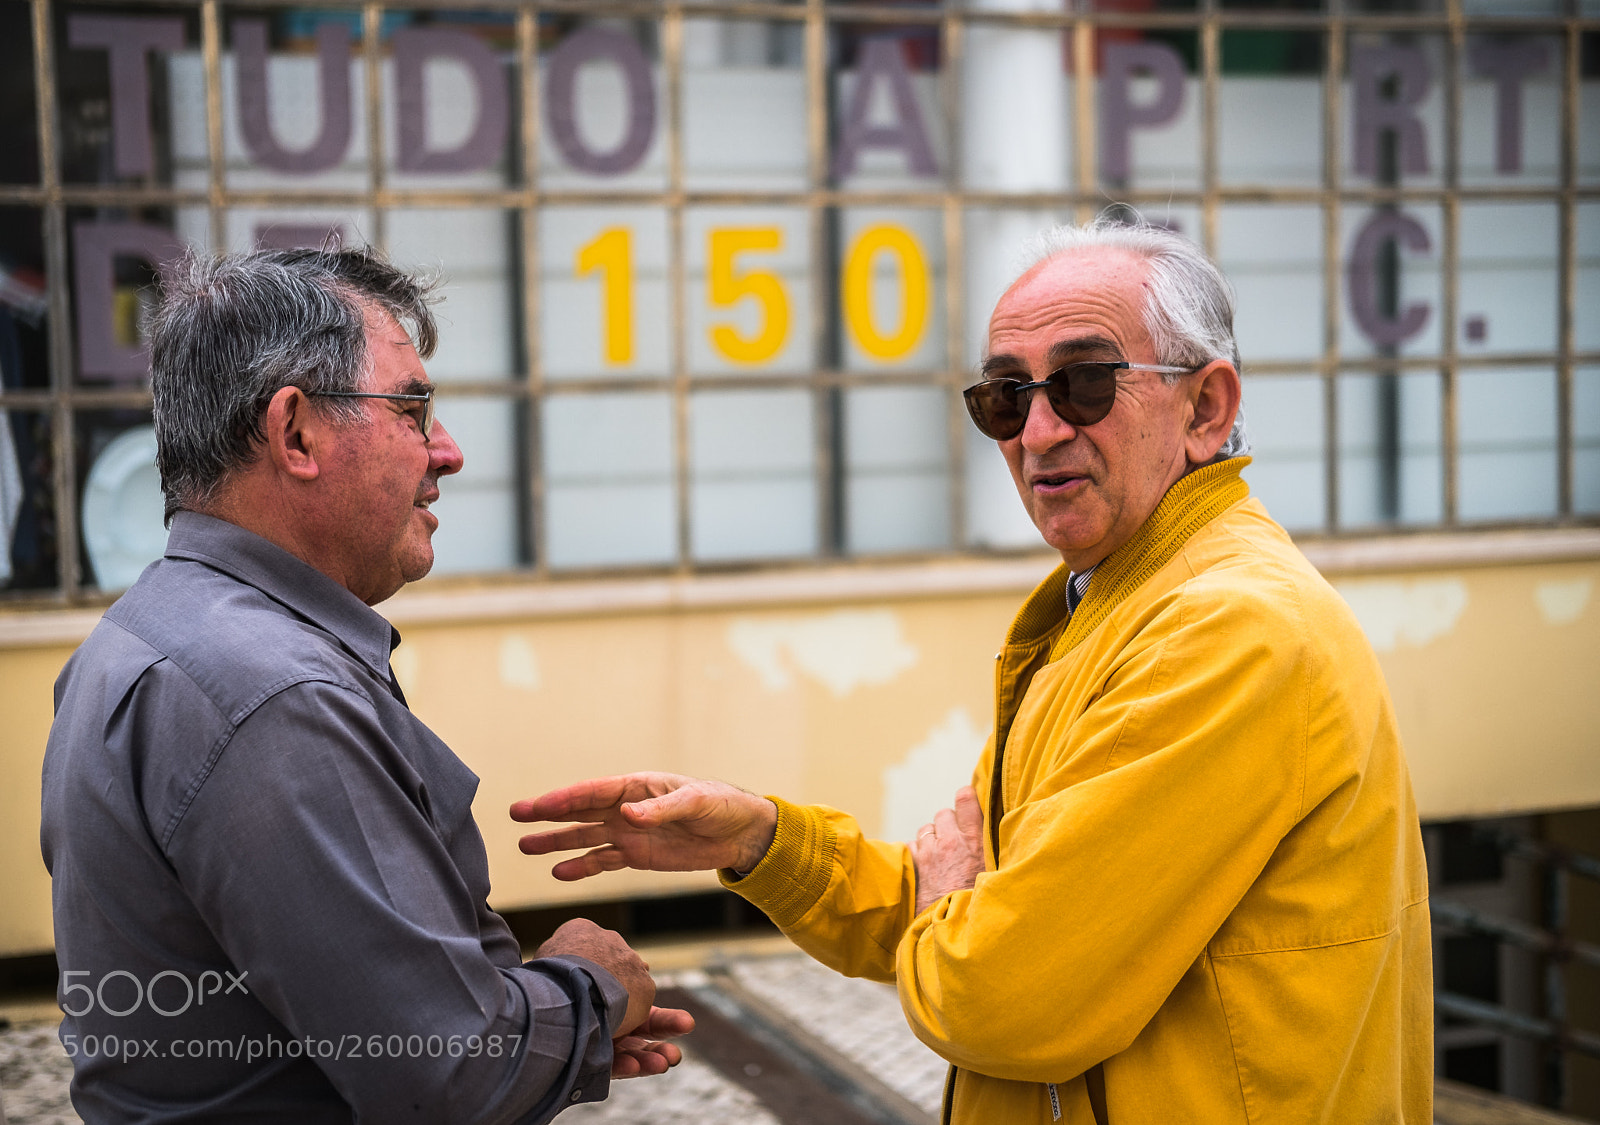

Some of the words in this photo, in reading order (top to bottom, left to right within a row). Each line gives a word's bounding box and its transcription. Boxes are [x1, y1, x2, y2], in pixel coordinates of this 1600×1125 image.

[68, 14, 657, 178] TUDO
[830, 34, 941, 179] A
[573, 221, 933, 367] 150
